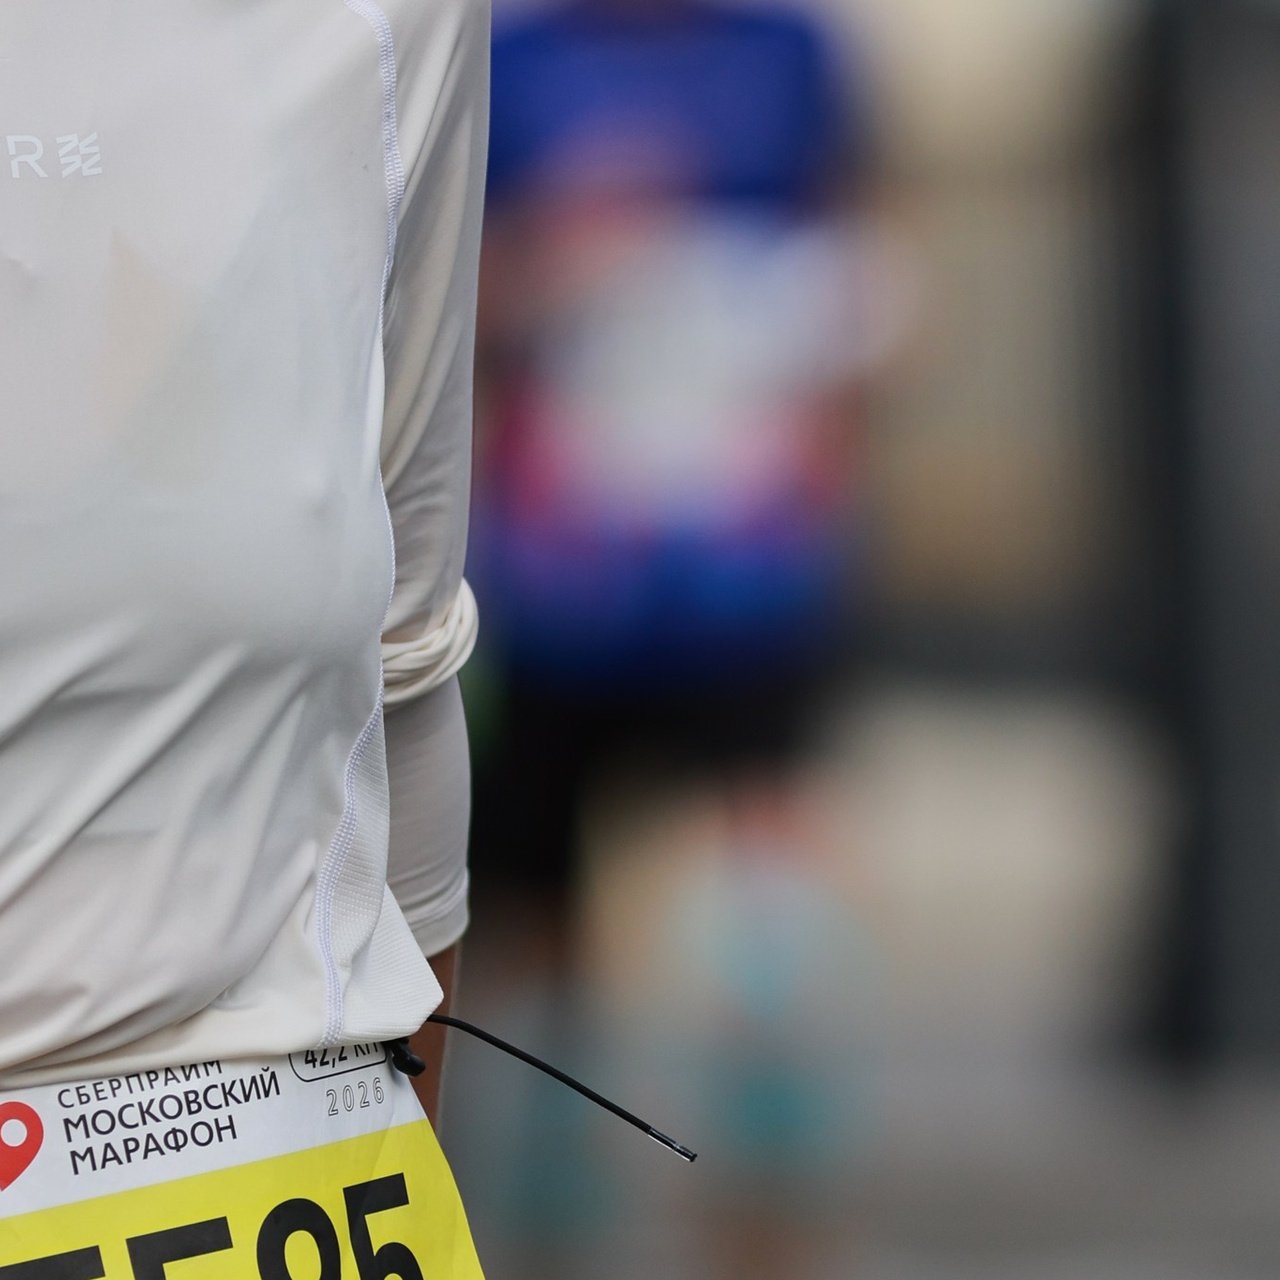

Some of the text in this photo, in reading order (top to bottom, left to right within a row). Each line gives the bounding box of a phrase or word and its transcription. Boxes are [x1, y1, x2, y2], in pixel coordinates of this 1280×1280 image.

[63, 1066, 281, 1143] МОСКОВСКИЙ
[326, 1077, 385, 1116] 2026
[69, 1115, 238, 1175] МАРАФОН
